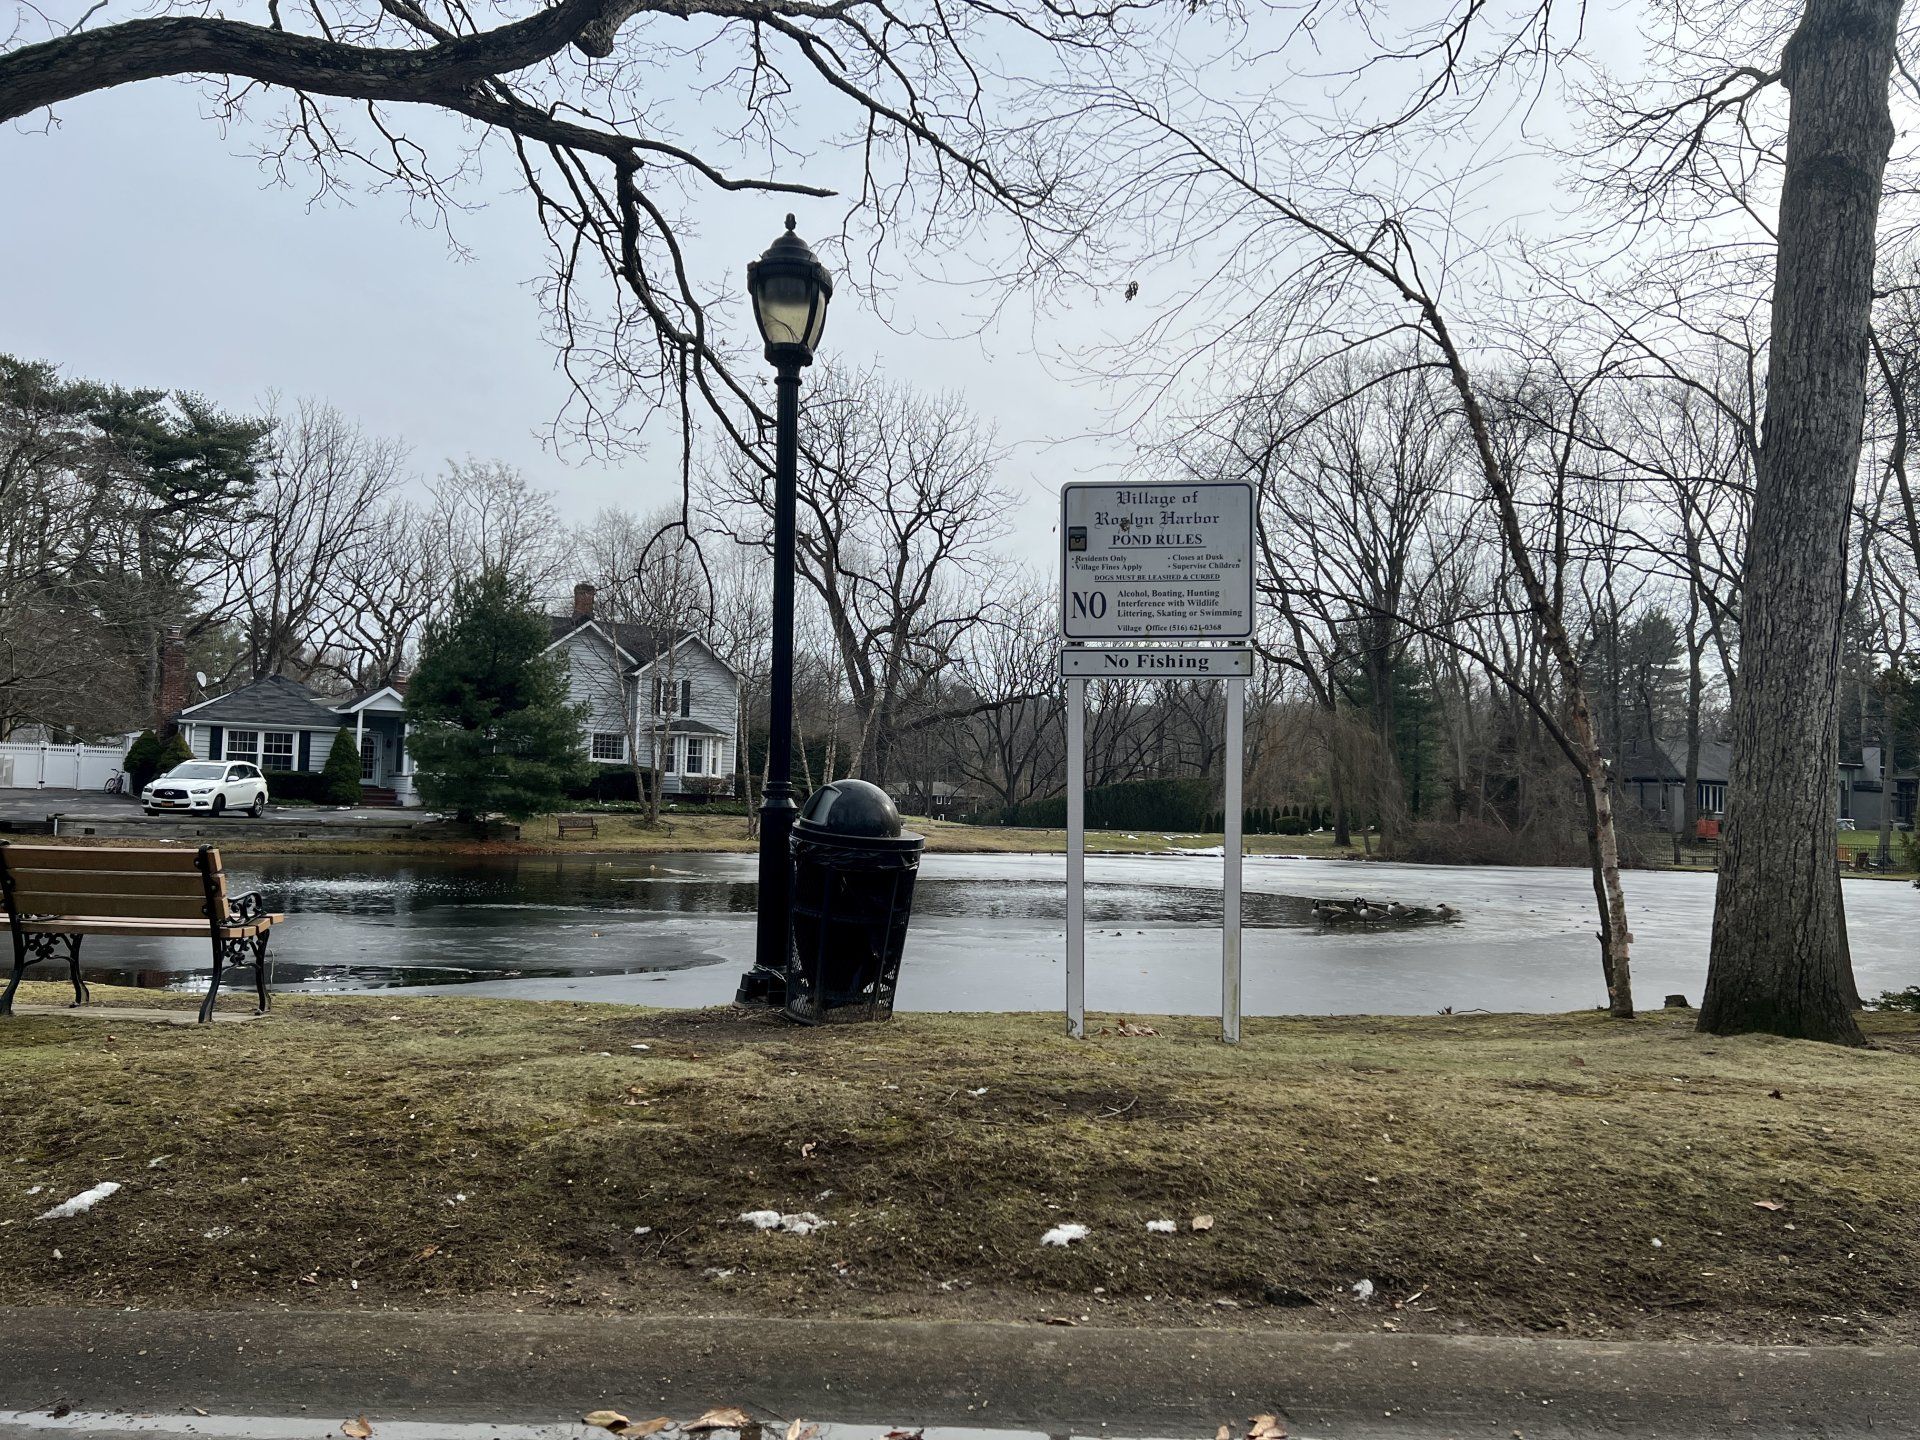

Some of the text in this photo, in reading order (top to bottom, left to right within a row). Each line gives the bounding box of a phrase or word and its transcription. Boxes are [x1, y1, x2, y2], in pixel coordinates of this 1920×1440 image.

[1116, 491, 1199, 507] Village of
[1159, 511, 1220, 528] Harbor
[1112, 534, 1203, 545] POND RULES
[1072, 591, 1106, 619] NO
[1104, 654, 1209, 671] No Fishing
